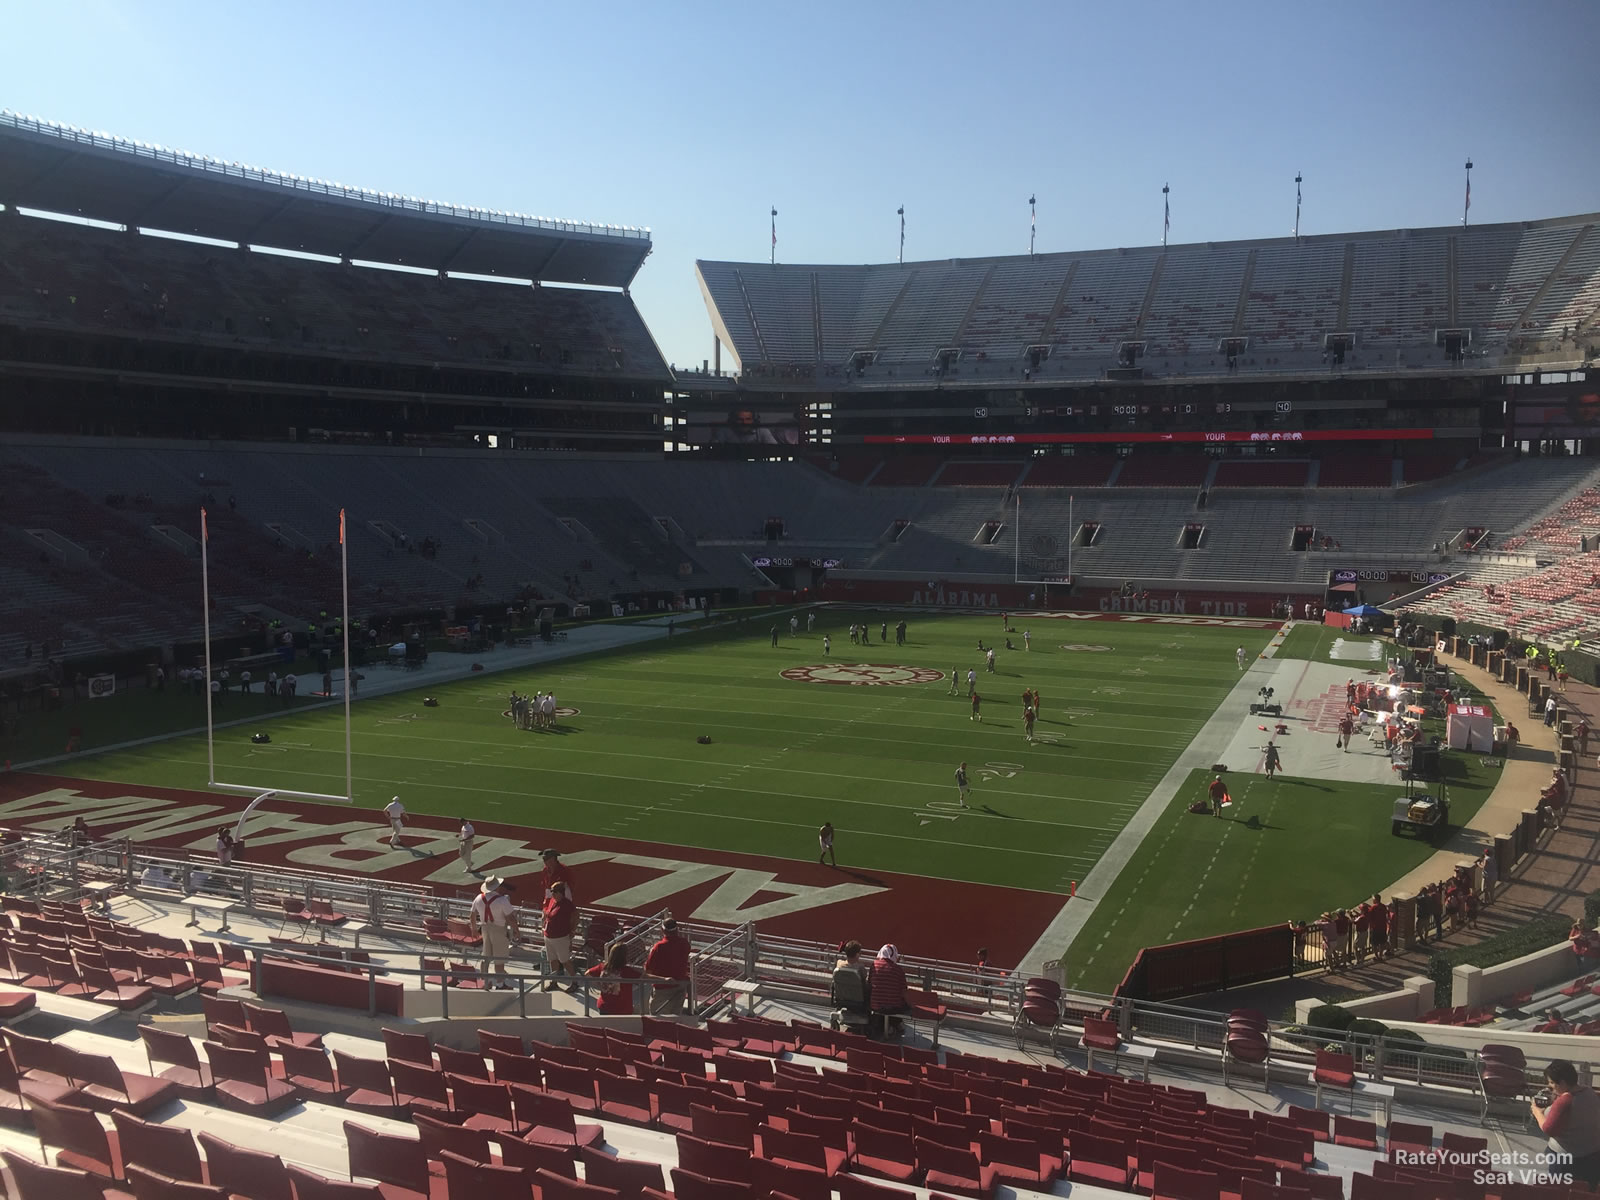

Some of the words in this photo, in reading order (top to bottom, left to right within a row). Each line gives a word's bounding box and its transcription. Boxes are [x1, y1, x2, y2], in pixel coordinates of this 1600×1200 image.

[932, 436, 951, 444] YOUR
[1205, 433, 1226, 441] YOUR
[1413, 573, 1425, 582] 40
[912, 590, 999, 607] ALABAMA
[1099, 597, 1186, 613] CRIMSON
[1200, 601, 1248, 616] TIDE
